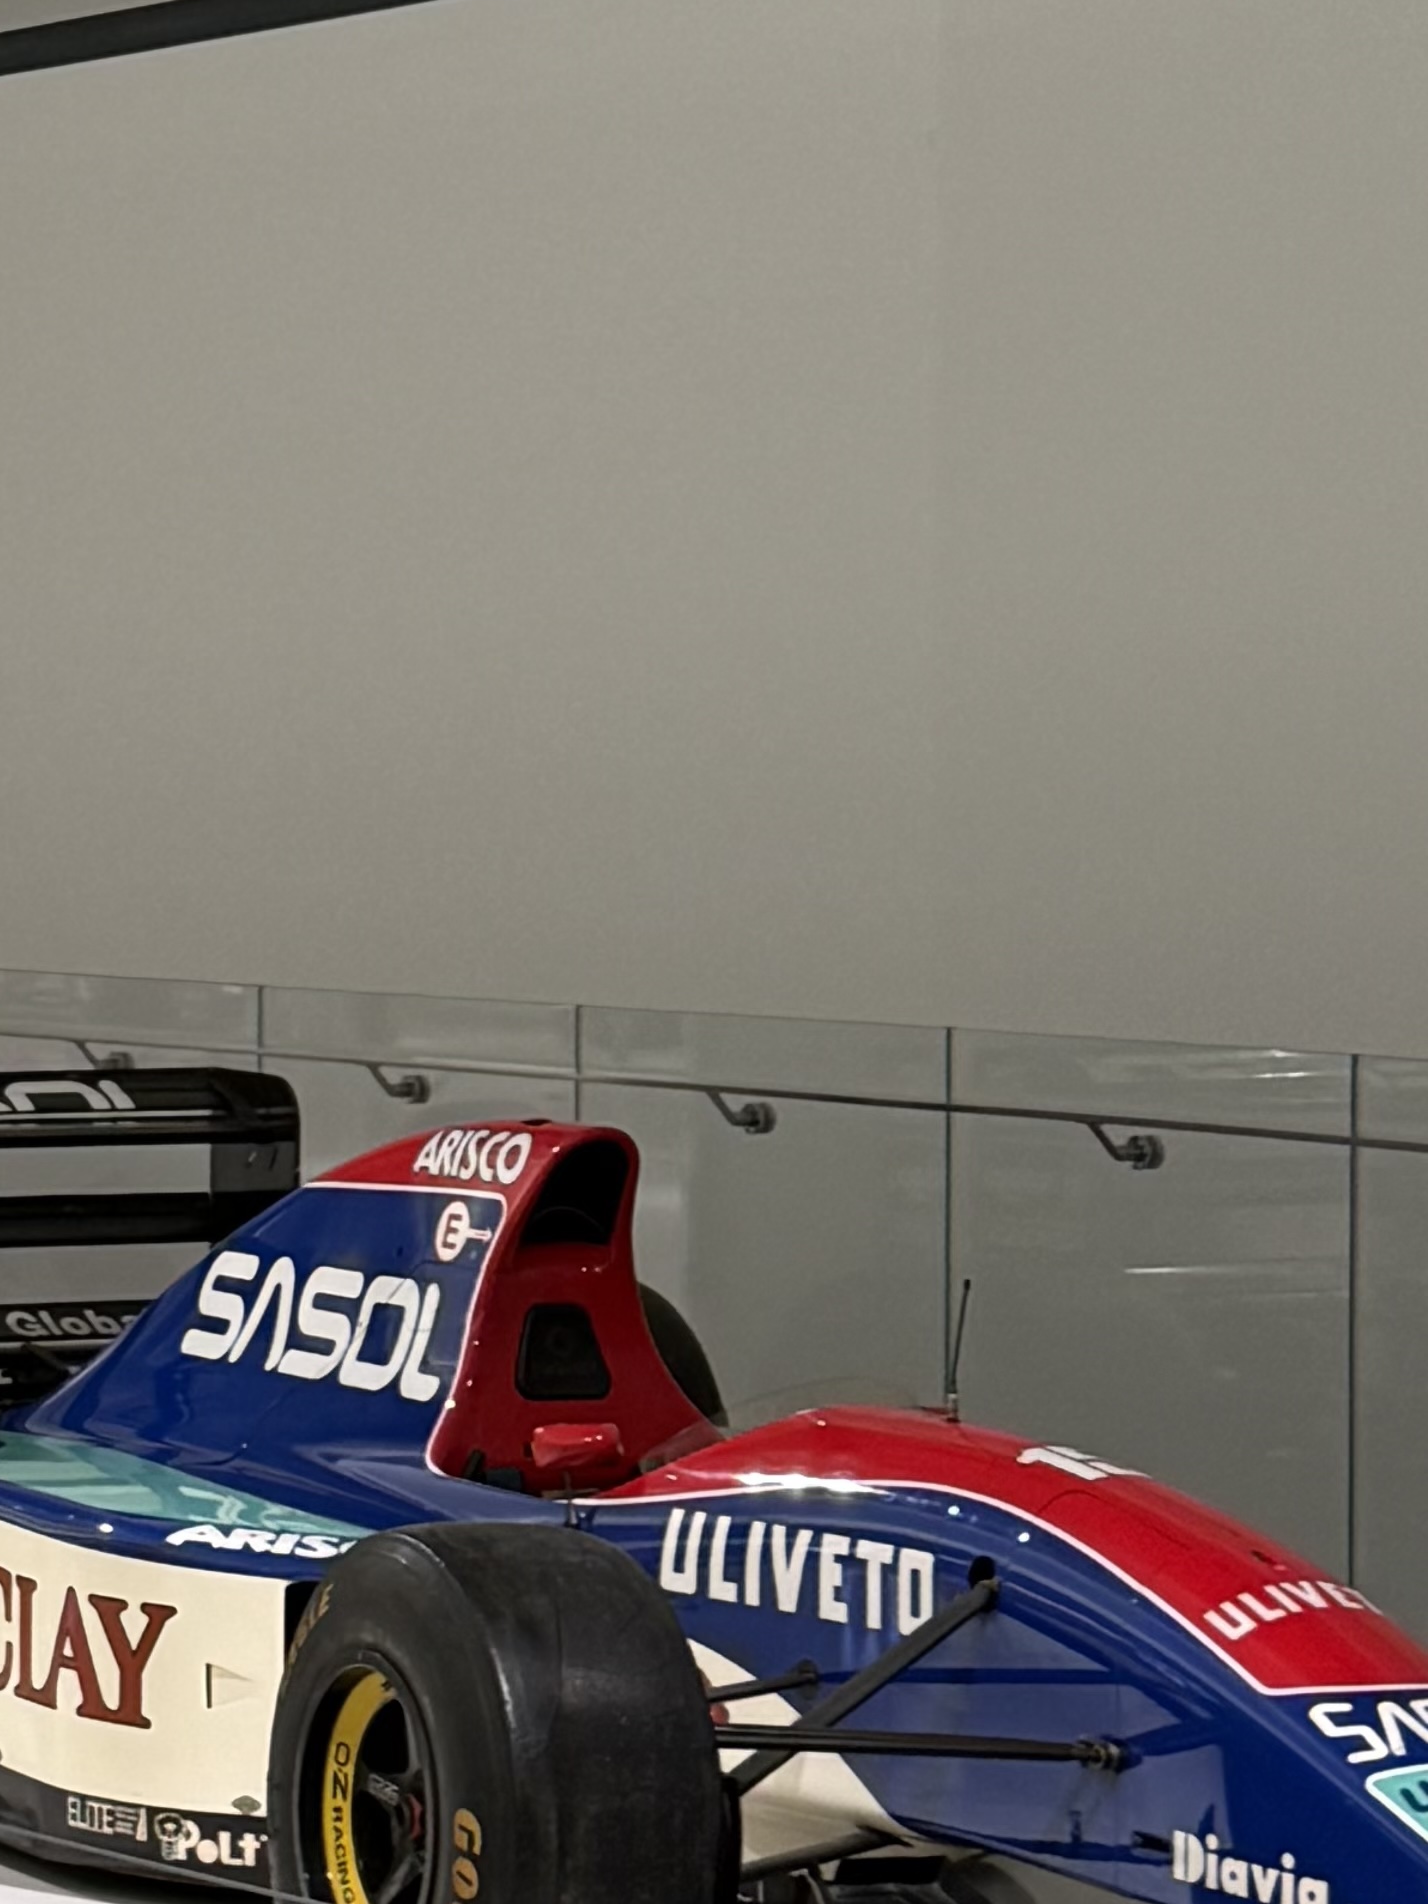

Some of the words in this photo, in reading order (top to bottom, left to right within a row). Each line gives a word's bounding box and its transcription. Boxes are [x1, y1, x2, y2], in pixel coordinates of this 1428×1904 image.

[413, 1129, 533, 1185] ARISCO
[180, 1250, 442, 1402] SASOL
[165, 1524, 358, 1559] ARIS
[660, 1508, 936, 1635] ULIVETO
